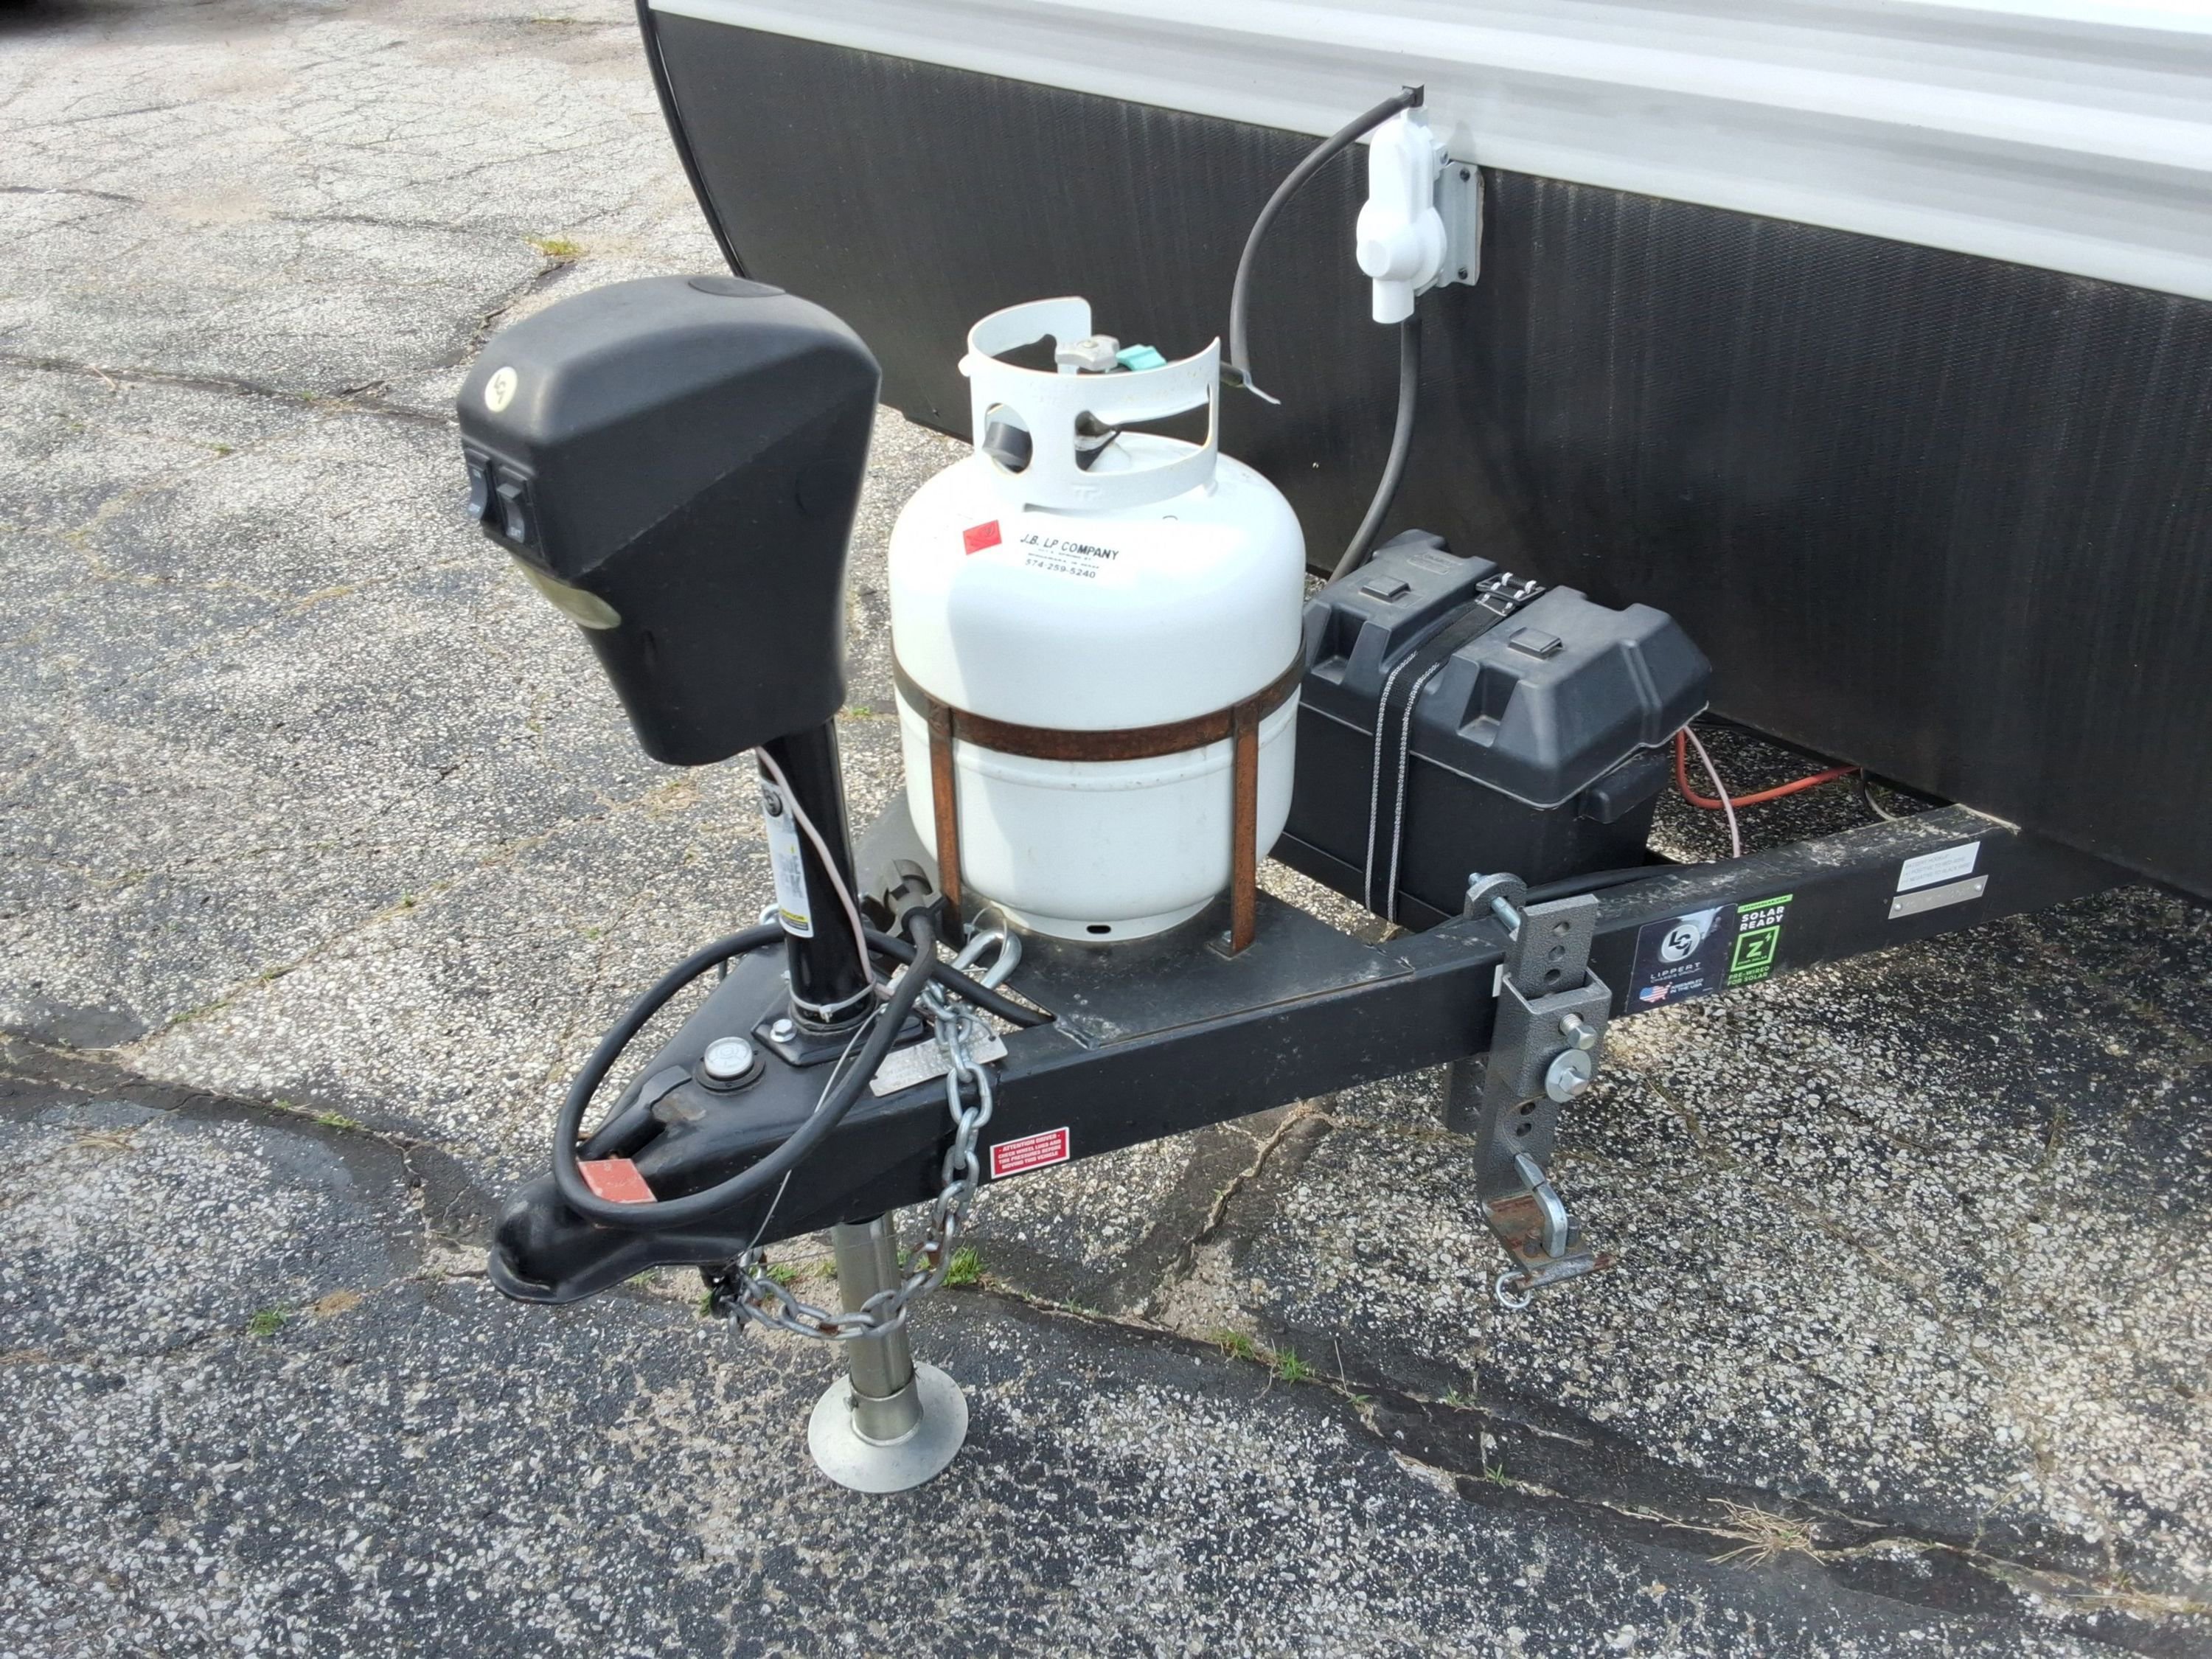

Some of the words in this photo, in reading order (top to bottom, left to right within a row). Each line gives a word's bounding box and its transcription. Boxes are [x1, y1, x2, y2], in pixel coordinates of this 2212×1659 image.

[1020, 534, 1039, 546] J.B.
[1043, 538, 1059, 549] LP
[1062, 542, 1119, 560] COMPANY
[1026, 559, 1096, 578] 574-259-5240
[1740, 914, 1784, 931] READY
[1742, 906, 1785, 922] SOLAR
[1746, 941, 1764, 959] Z
[1650, 962, 1701, 979] LIPPERT
[1729, 966, 1770, 980] PRE-WIRED
[1728, 978, 1742, 987] FOR
[1744, 973, 1768, 982] SOLAR
[1003, 1139, 1035, 1152] ATTENTION
[1036, 1134, 1057, 1144] DRIVER
[998, 1151, 1016, 1159] CHECK
[1016, 1146, 1034, 1155] WHEEL
[1002, 1160, 1024, 1169] MOVING
[1037, 1151, 1058, 1161] VEHICLE
[1011, 1150, 1041, 1161] PRESSURES
[1041, 1144, 1061, 1154] BEFORE
